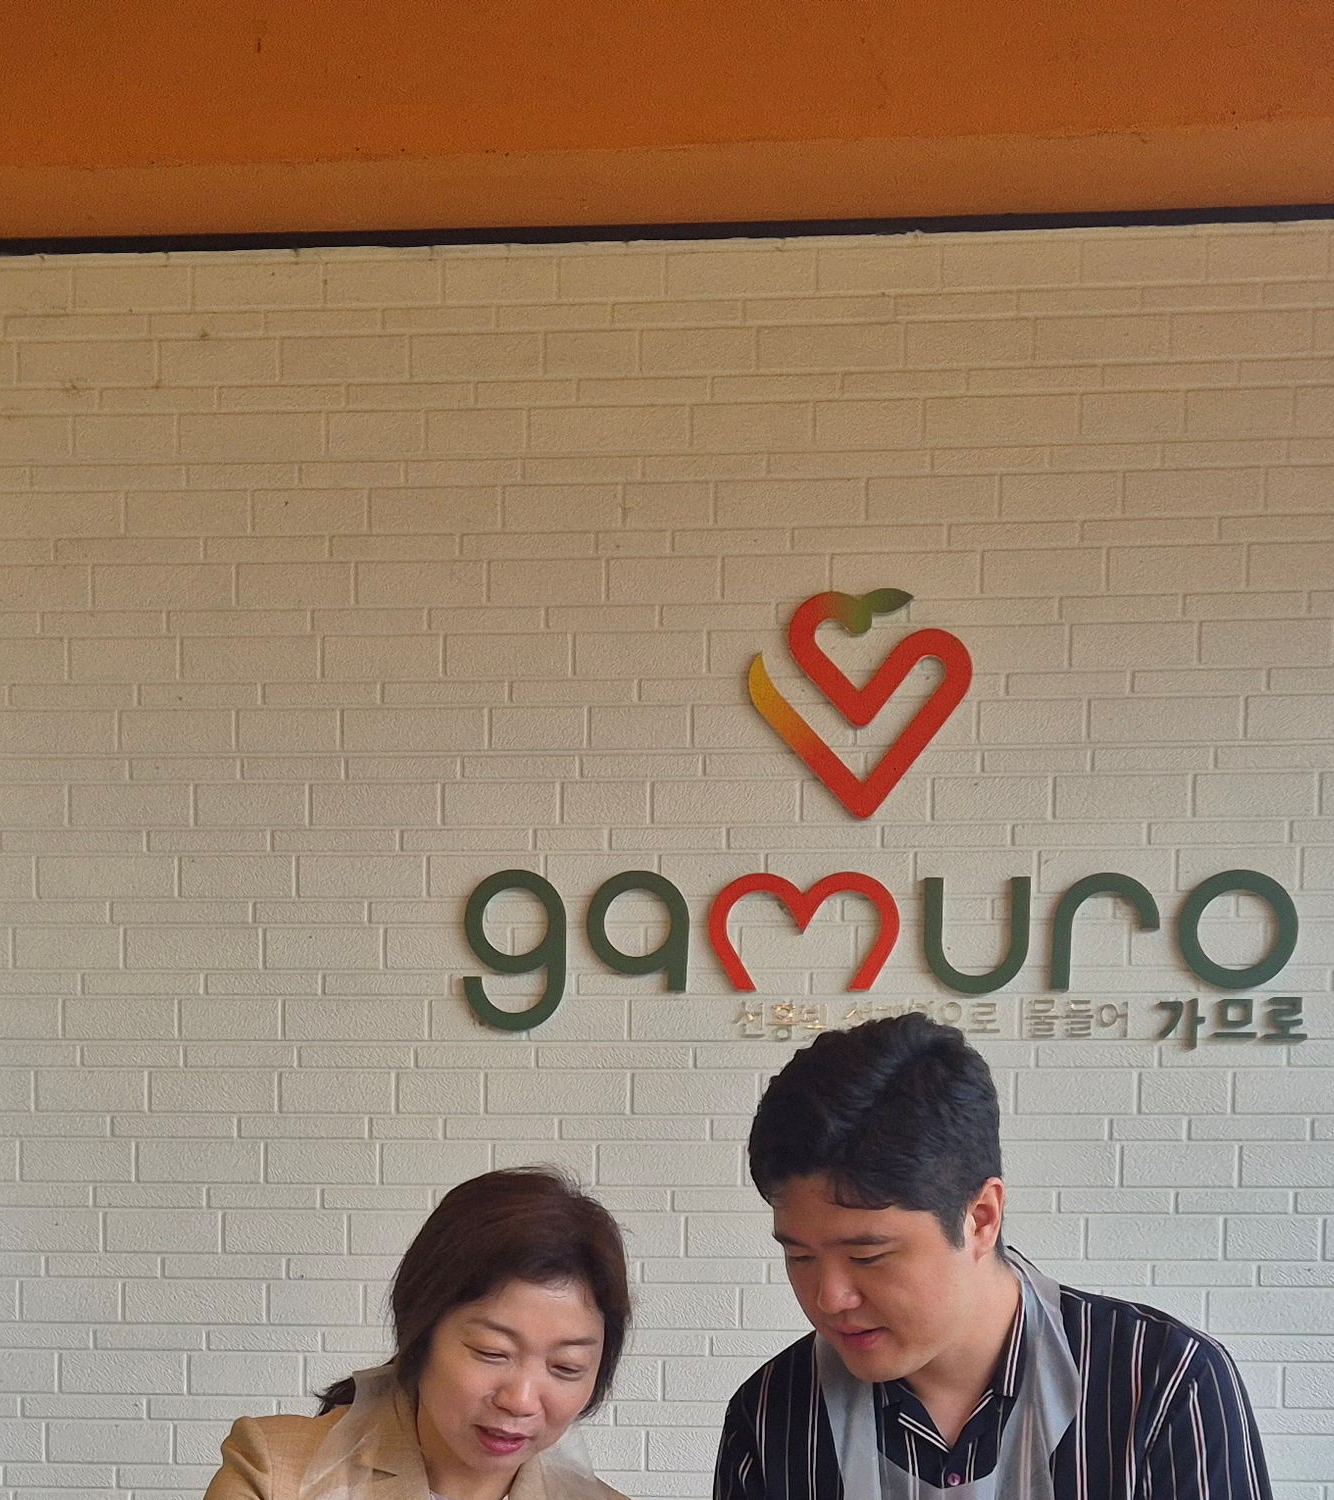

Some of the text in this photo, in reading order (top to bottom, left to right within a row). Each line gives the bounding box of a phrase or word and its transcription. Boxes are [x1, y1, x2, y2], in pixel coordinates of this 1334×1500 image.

[463, 869, 1299, 1032] gamuro
[1024, 998, 1128, 1038] 물들어
[1153, 997, 1308, 1050] 가므로
